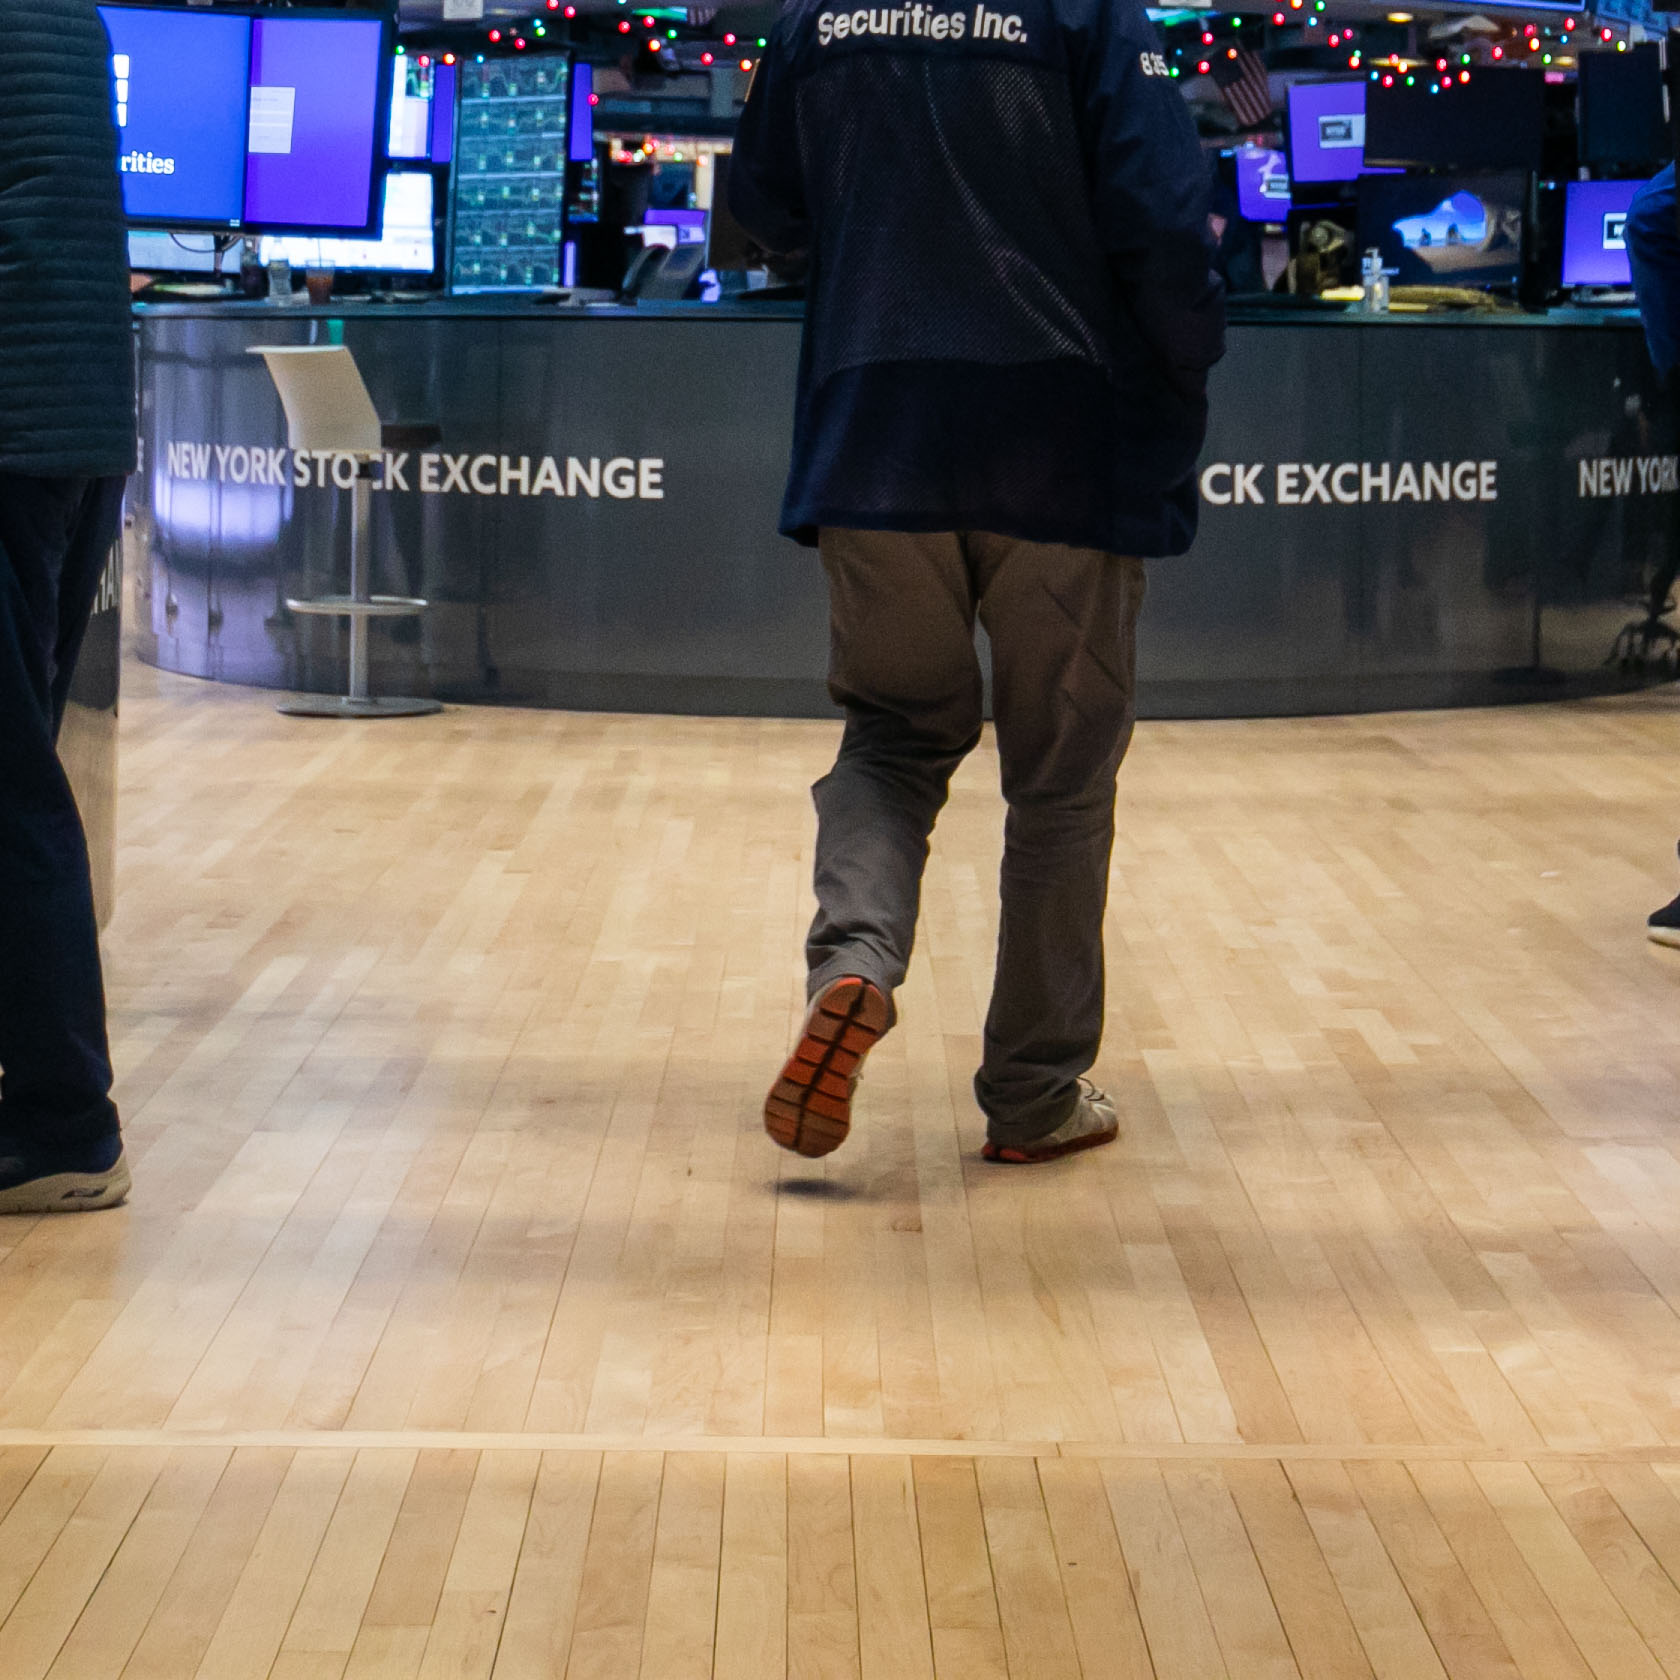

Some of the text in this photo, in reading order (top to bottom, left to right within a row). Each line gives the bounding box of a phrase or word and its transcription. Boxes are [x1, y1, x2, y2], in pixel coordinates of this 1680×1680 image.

[818, 1, 1029, 47] Securities Inc.
[120, 151, 176, 177] rities
[166, 441, 212, 481] NEW
[213, 445, 287, 488] YORK
[420, 452, 665, 501] EXCHANGE
[1276, 460, 1499, 505] EXCHANGE
[1578, 455, 1680, 499] NEW YORK
